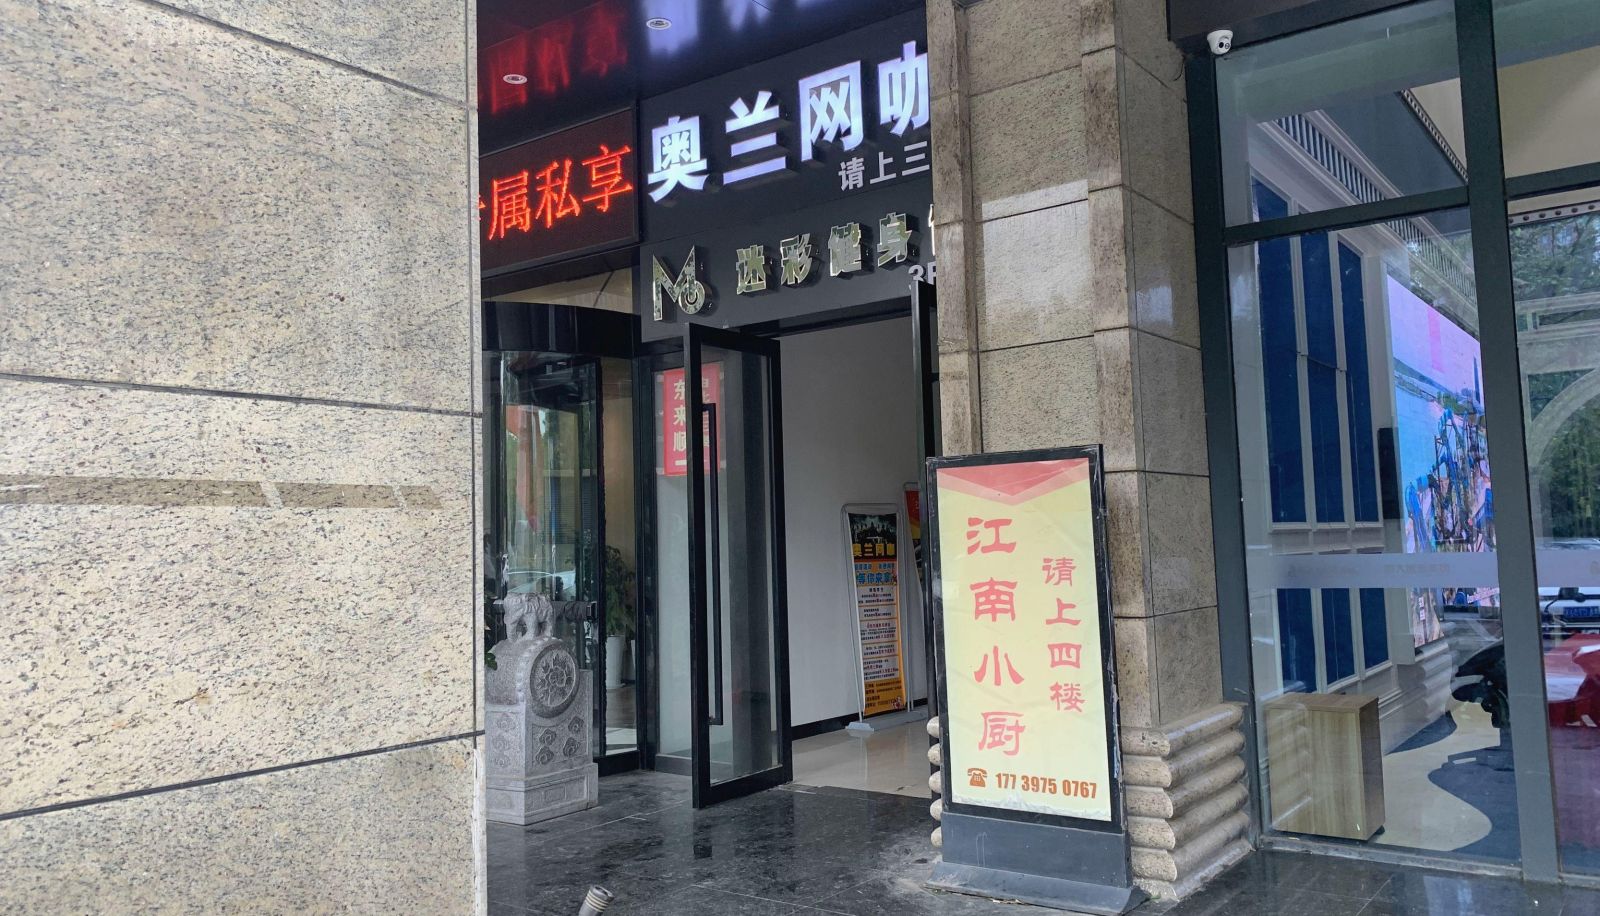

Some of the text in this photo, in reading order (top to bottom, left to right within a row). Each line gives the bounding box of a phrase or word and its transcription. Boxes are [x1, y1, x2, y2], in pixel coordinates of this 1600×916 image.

[479, 143, 634, 241] 属私享
[838, 140, 930, 192] 请上三
[735, 203, 936, 296] 迷彩健身
[966, 516, 1026, 757] 江南小厨
[1041, 556, 1085, 713] 请上四楼
[995, 772, 1098, 799] 177 3975 0767
